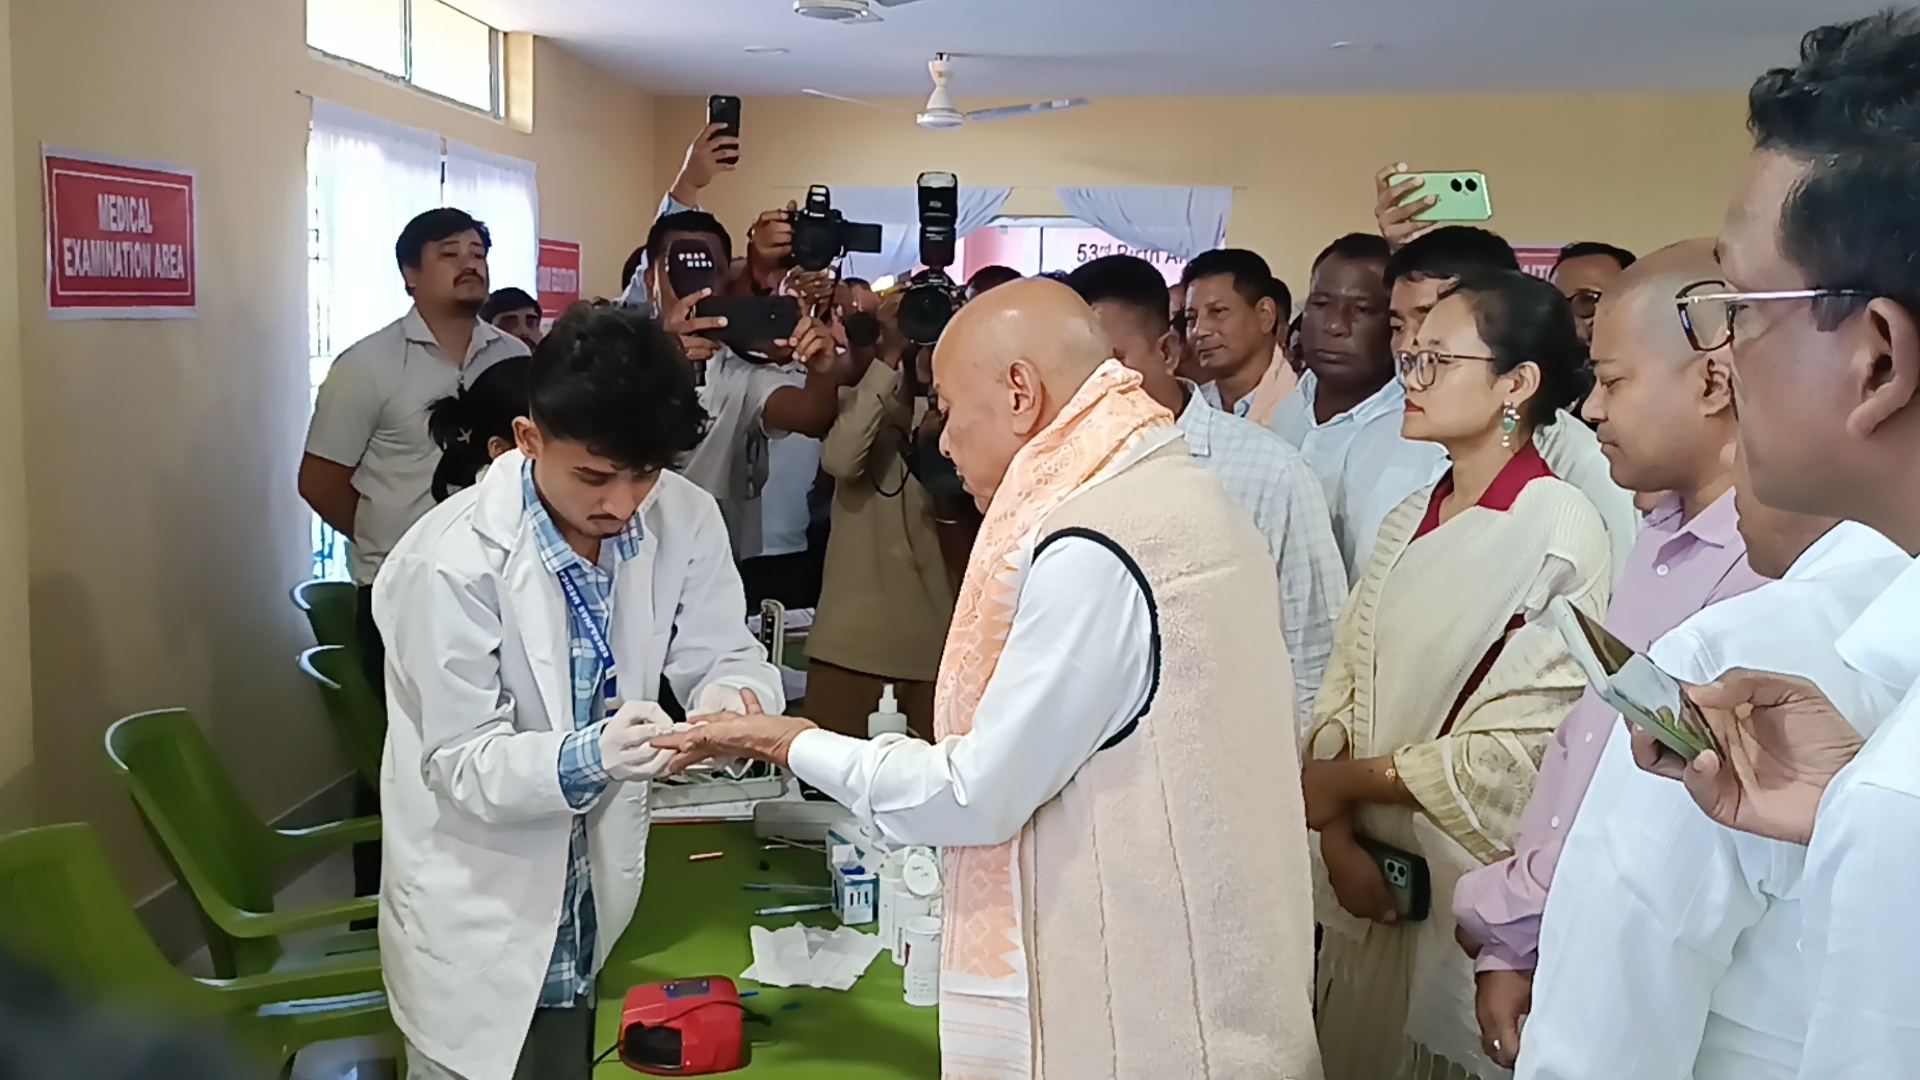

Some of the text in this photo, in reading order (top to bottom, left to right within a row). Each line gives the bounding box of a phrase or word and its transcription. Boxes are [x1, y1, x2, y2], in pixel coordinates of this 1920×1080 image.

[98, 193, 153, 233] MEDICAL
[63, 237, 185, 279] EXAMINATION AREA
[1077, 243, 1112, 263] 53rd
